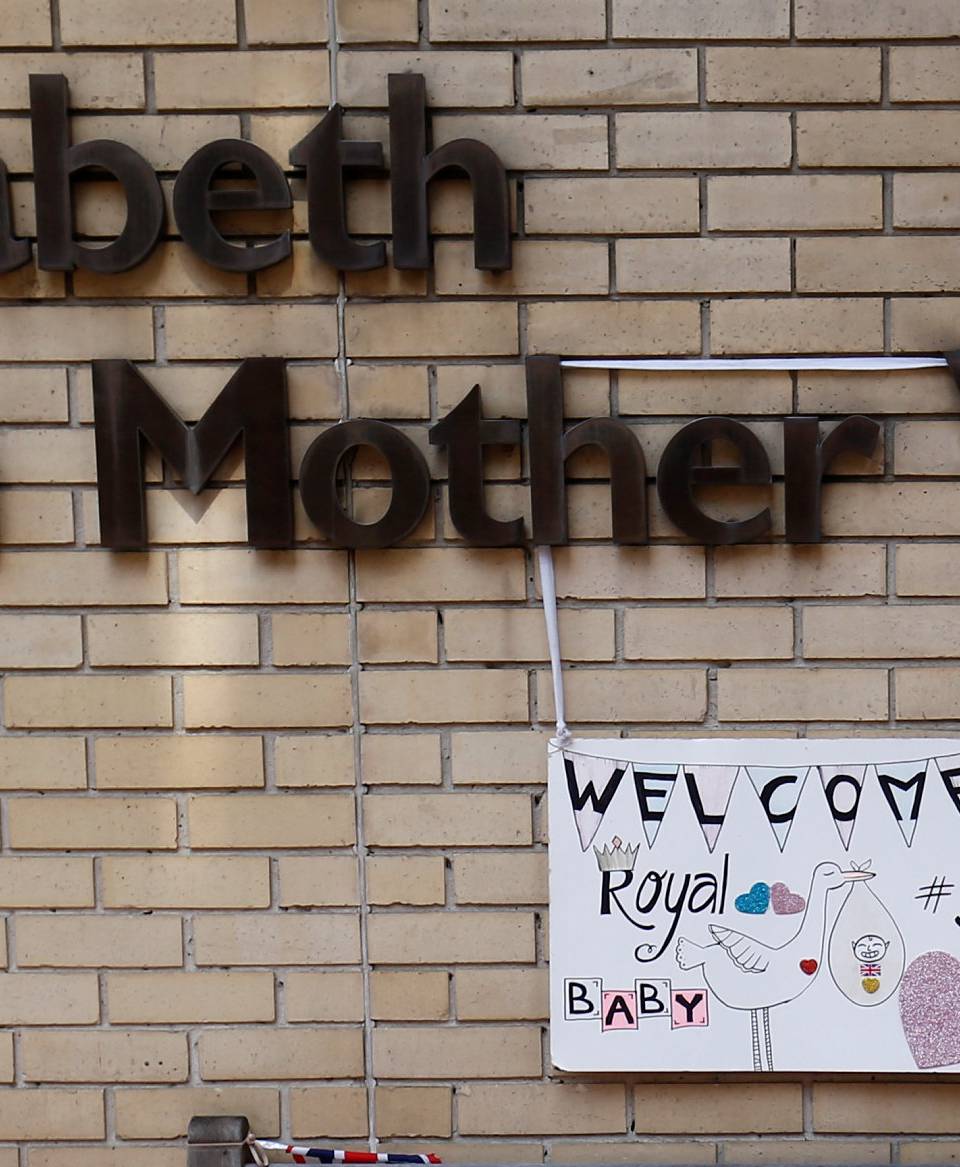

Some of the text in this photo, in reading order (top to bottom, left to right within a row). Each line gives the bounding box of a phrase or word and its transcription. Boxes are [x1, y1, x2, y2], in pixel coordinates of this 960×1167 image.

[92, 354, 881, 550] Mother
[599, 853, 730, 963] Royal
[568, 982, 704, 1027] BABY
